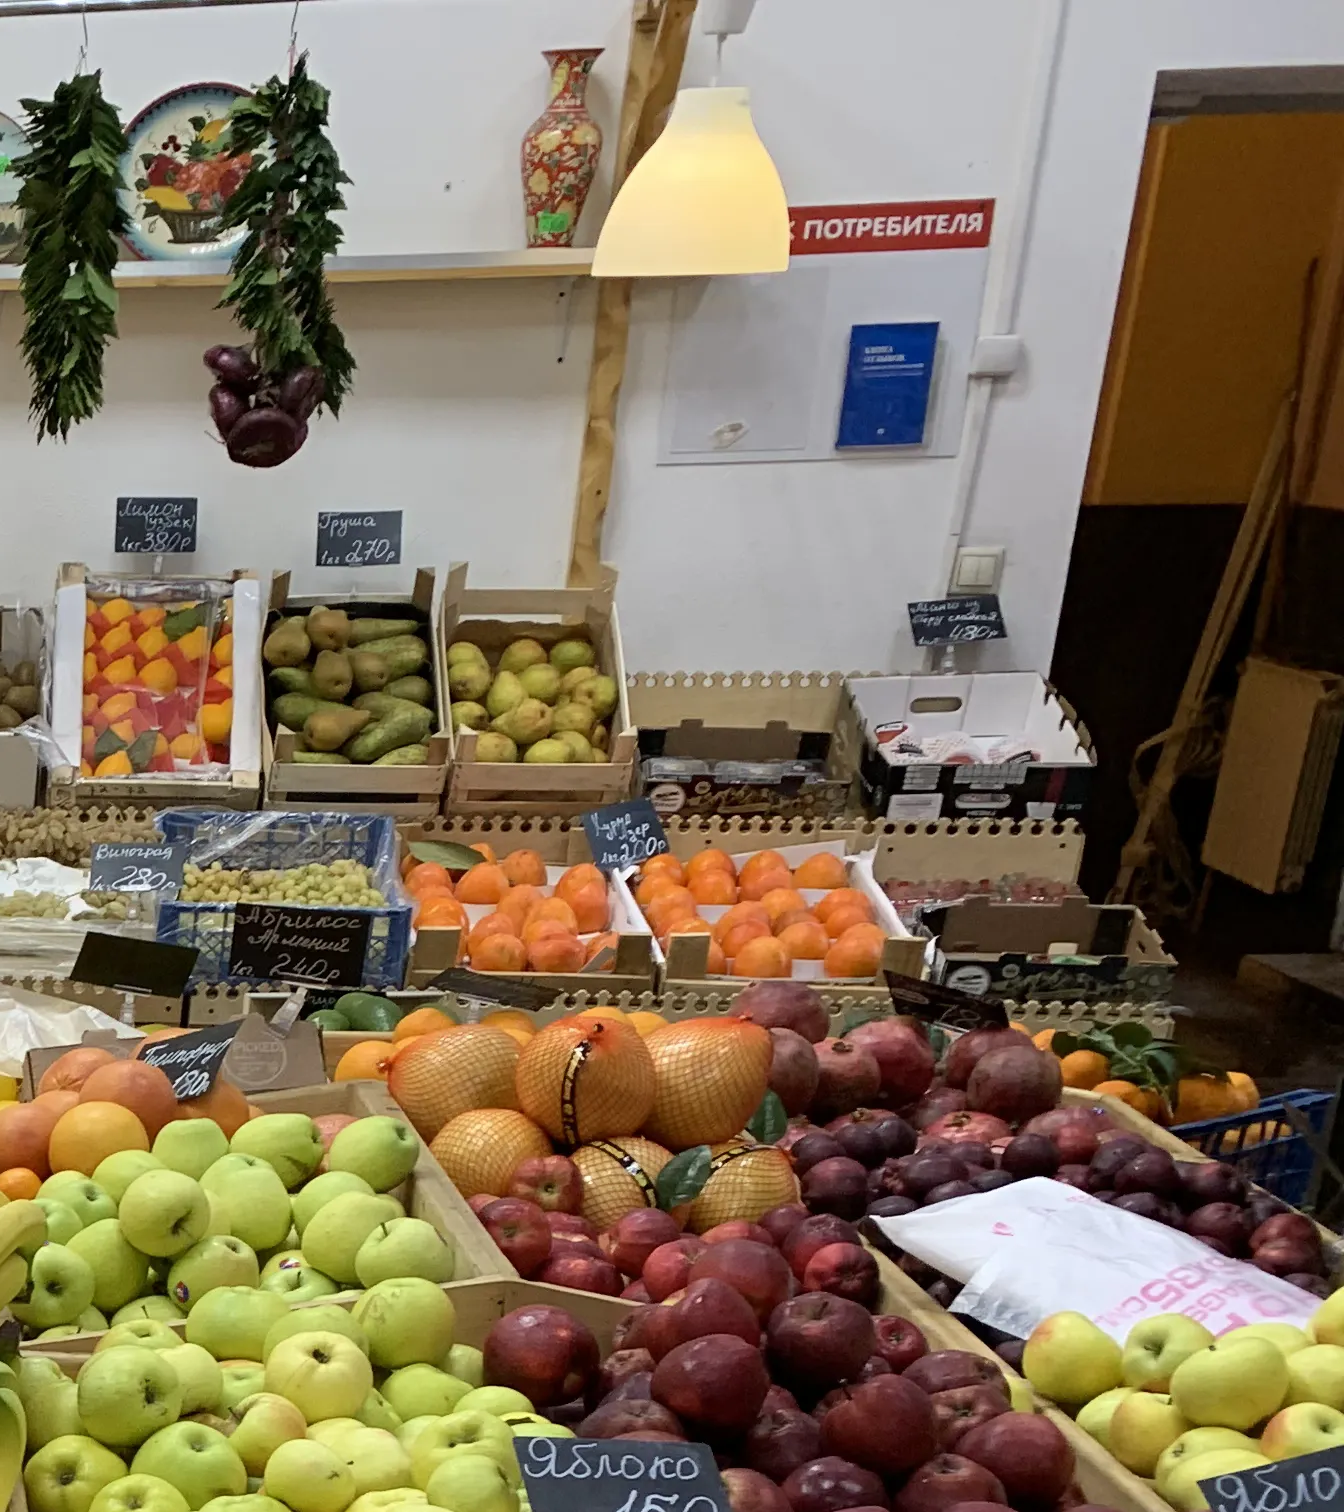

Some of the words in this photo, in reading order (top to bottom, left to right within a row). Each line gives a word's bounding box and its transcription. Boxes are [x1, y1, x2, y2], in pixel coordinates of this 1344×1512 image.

[803, 212, 984, 240] ПОТРЕБИТЕЛЯ
[318, 512, 377, 537] Груша
[96, 843, 174, 861] Виноград
[235, 908, 363, 933] Абрикос
[524, 1437, 700, 1481] Яблоко
